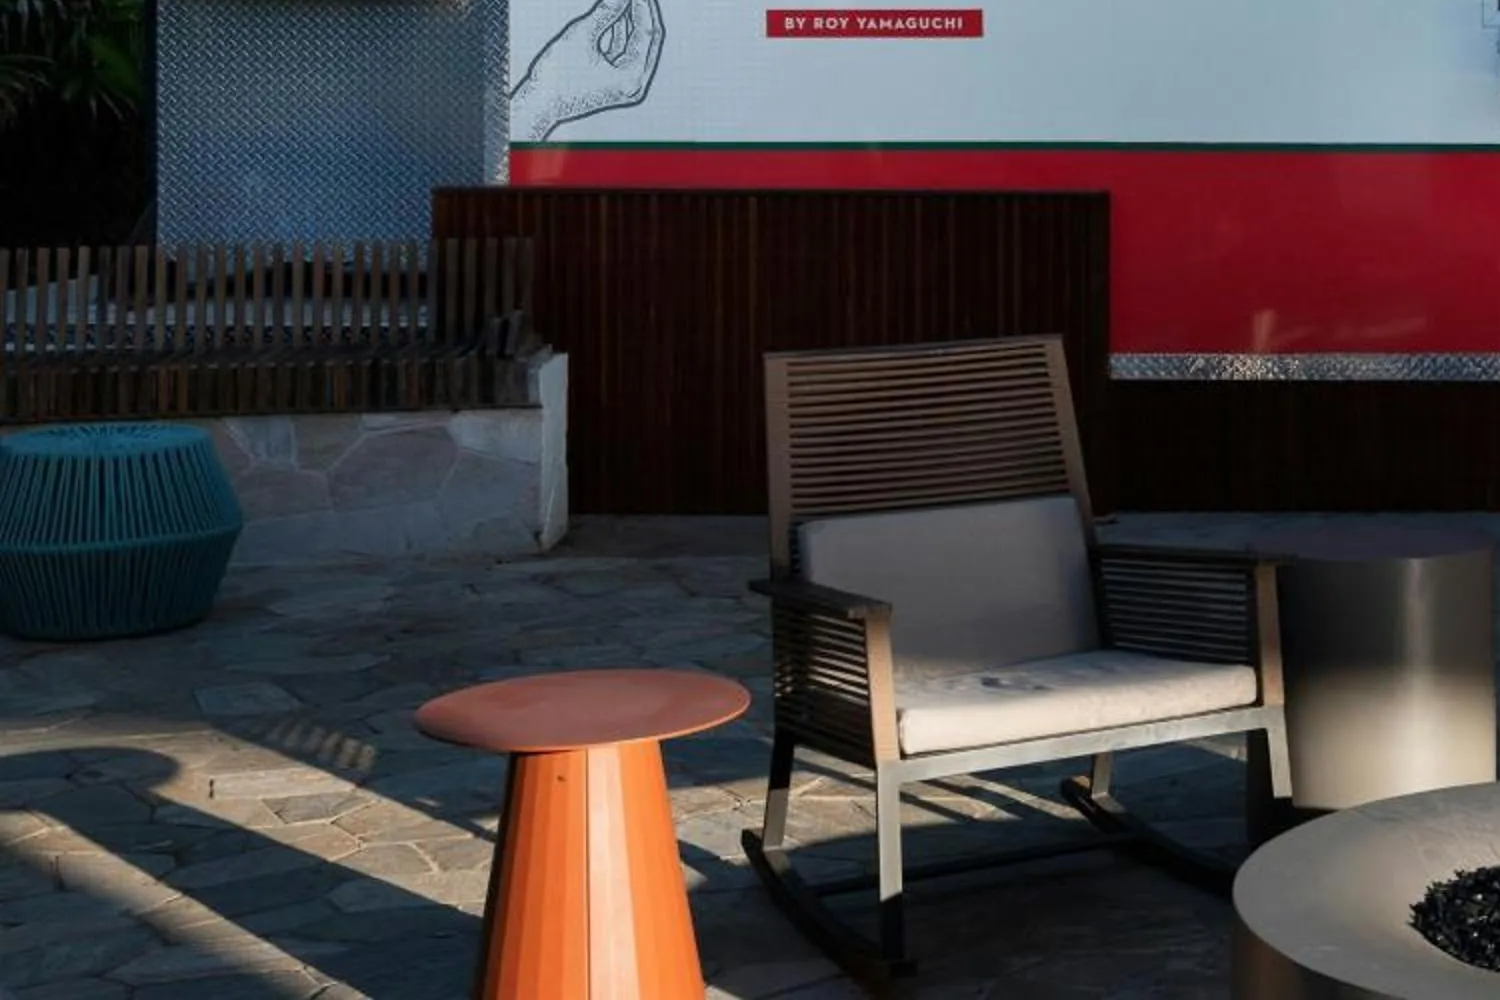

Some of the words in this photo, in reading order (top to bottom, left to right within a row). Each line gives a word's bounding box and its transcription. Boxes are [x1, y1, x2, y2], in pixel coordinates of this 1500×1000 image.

[784, 16, 806, 30] BY
[813, 16, 849, 30] ROY
[856, 16, 964, 30] YAMAGUCHI
